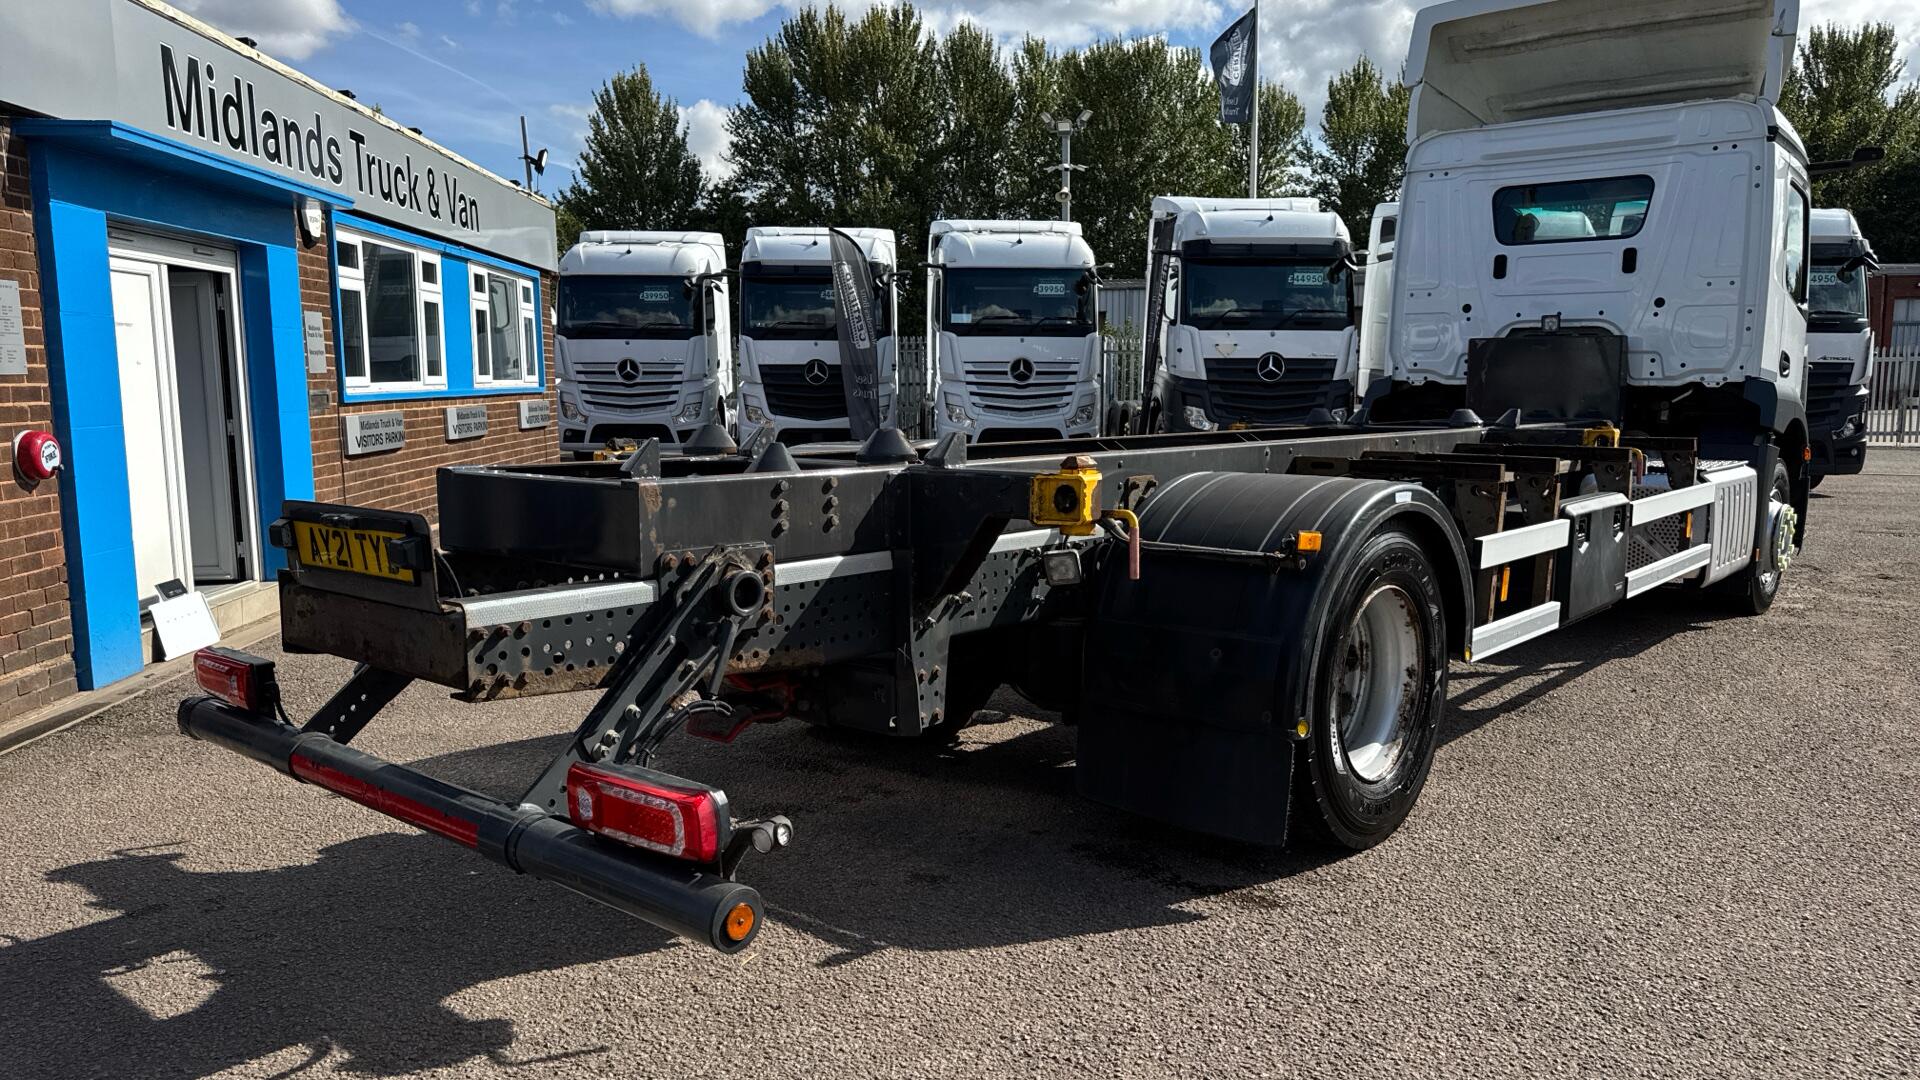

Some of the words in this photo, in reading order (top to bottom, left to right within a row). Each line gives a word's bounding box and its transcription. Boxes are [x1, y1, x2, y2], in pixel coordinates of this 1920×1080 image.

[160, 41, 343, 186] Midlands
[349, 128, 423, 214] Truck
[427, 165, 442, 221] &
[443, 171, 480, 234] Van
[1811, 274, 1835, 283] 4950
[360, 420, 379, 430] Midlands
[355, 432, 384, 448] VISITORS
[309, 526, 354, 568] AY21
